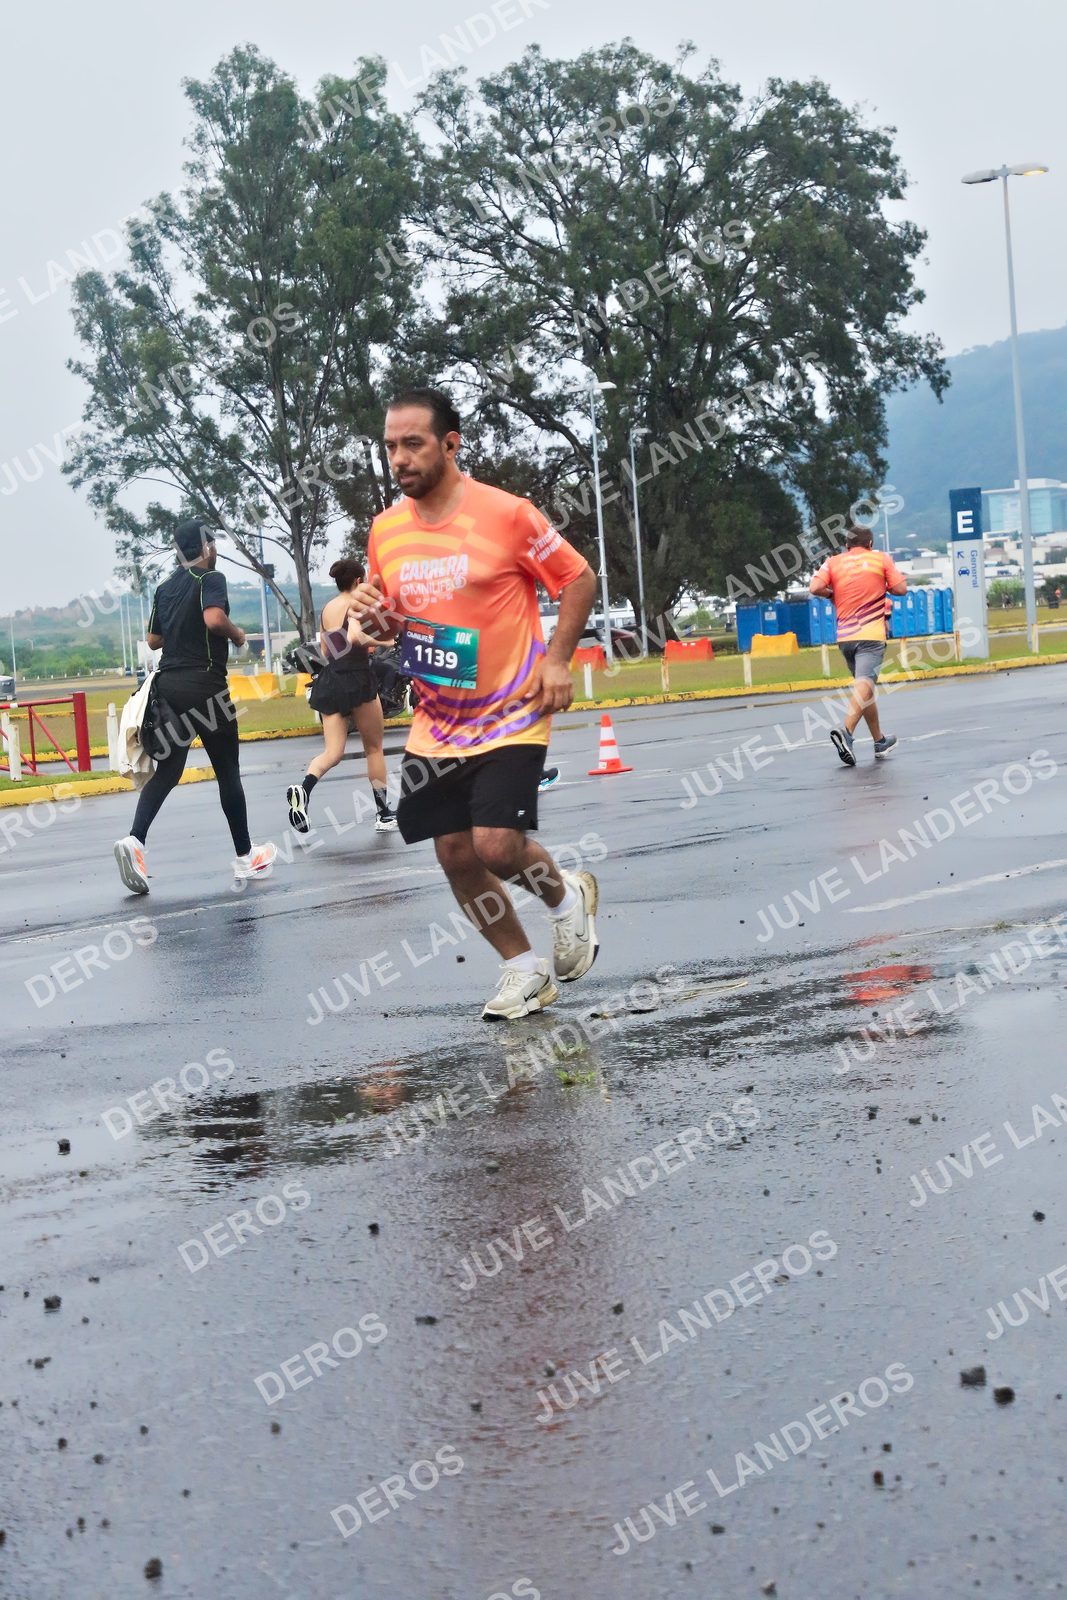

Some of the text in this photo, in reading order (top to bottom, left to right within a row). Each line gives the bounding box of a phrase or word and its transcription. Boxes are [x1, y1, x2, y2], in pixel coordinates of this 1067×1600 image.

[957, 510, 974, 534] E
[400, 554, 468, 581] CARRERA
[970, 550, 978, 588] General
[400, 579, 454, 596] OMNILIFE
[455, 632, 472, 645] 10K
[414, 645, 458, 669] 1139
